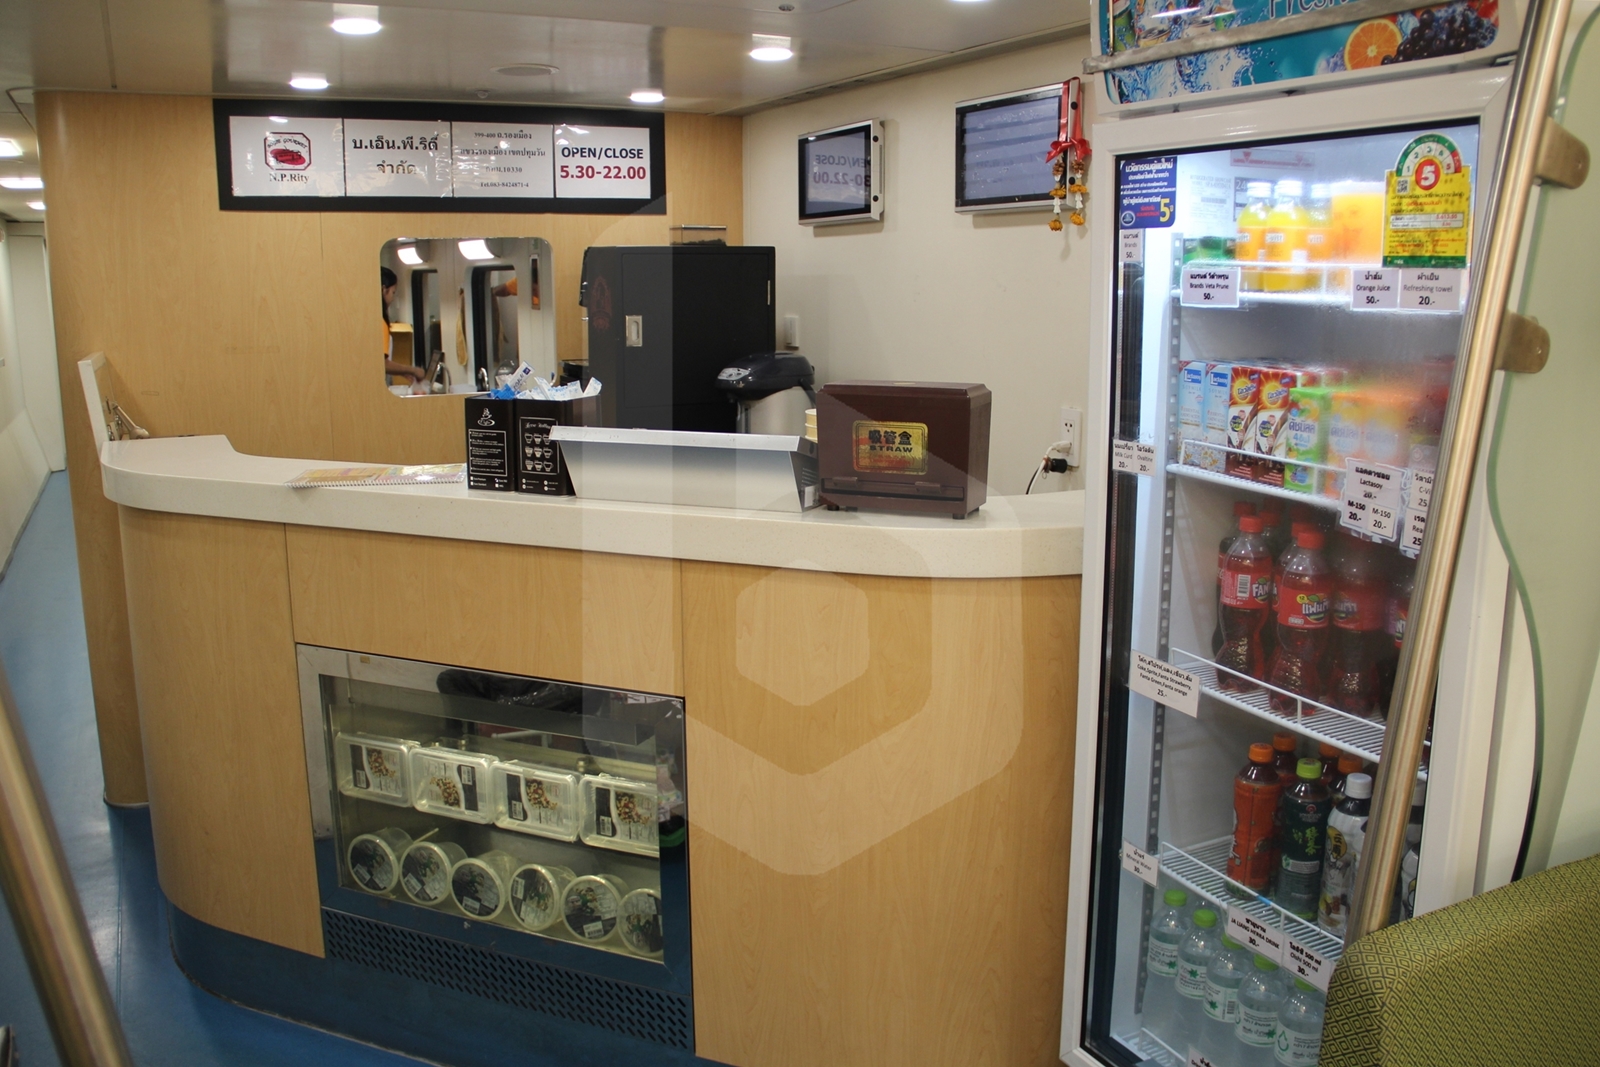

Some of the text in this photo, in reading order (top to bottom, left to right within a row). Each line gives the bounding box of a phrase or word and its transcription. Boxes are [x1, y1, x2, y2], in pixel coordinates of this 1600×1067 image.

[1268, 0, 1349, 19] Fres
[561, 146, 644, 160] OPEN/CLOSE
[376, 160, 418, 174] จำกัด
[560, 165, 646, 180] 5.30-22.00
[269, 173, 309, 183] N.P.Rity
[1420, 165, 1436, 187] 5
[1160, 198, 1170, 222] 5
[1356, 284, 1376, 292] Orange
[1403, 285, 1434, 293] Refreshing
[1203, 292, 1214, 300] 50.-
[1366, 296, 1380, 304] 50.-
[1419, 296, 1435, 305] 20.-
[868, 430, 912, 446] 吸管盒
[869, 445, 913, 453] STRAW
[1360, 478, 1383, 489] Lactasoy
[1363, 490, 1377, 499] 20.-
[1348, 500, 1366, 511] M-150
[1349, 511, 1361, 521] 20.-
[1372, 508, 1391, 519] M-150
[1373, 519, 1386, 529] 20.-
[1140, 673, 1150, 681] Fanta
[1174, 687, 1188, 697] orange
[1157, 689, 1167, 697] 25.-
[1249, 937, 1259, 947] 30.-
[1265, 936, 1280, 949] DRINK
[1290, 952, 1302, 962] Oishi
[1302, 960, 1311, 969] 500
[1304, 952, 1314, 961] 500
[1297, 966, 1308, 977] 30.-
